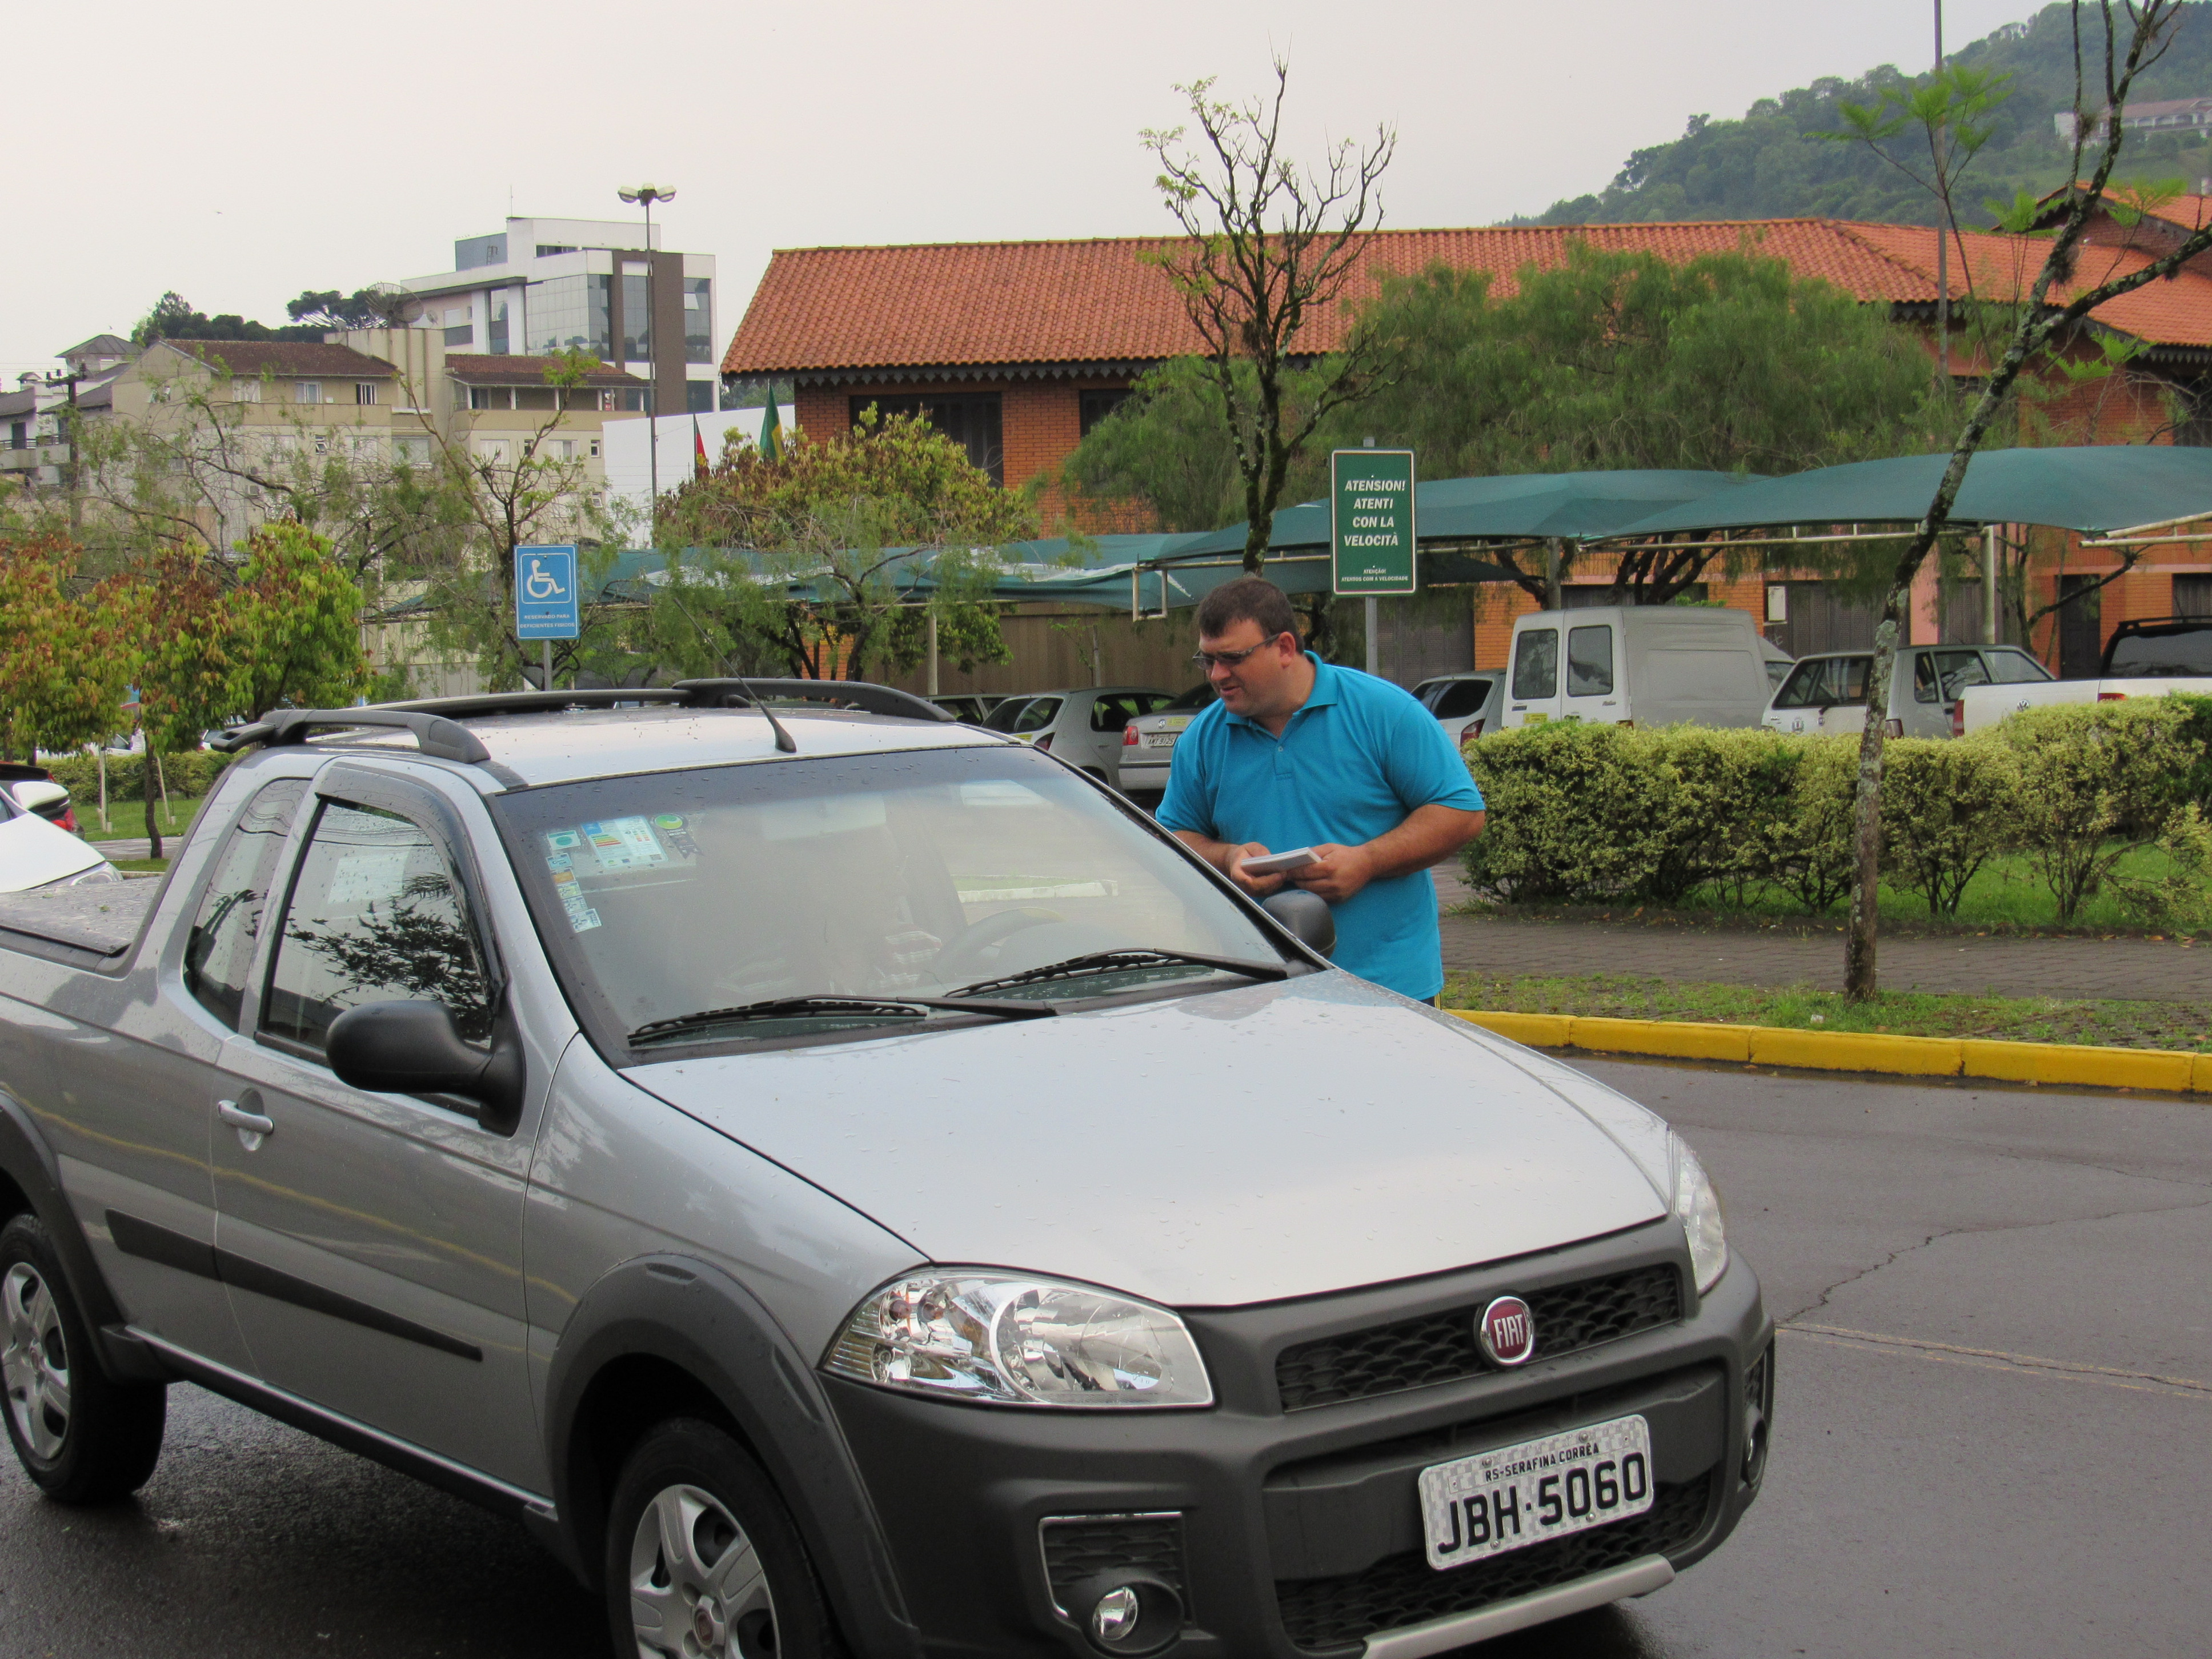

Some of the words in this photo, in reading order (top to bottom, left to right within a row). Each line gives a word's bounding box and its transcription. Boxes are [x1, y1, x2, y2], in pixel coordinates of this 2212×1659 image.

[1345, 480, 1405, 491] ATENSION!
[1353, 498, 1393, 509] ATENTI
[1353, 516, 1377, 528] CON
[1380, 516, 1394, 527] LA
[1344, 532, 1398, 546] VELOCITÀ
[1493, 1314, 1524, 1349] FIAT
[1486, 1453, 1556, 1482] RS-SERAFINA
[1559, 1442, 1599, 1462] CORRÊA
